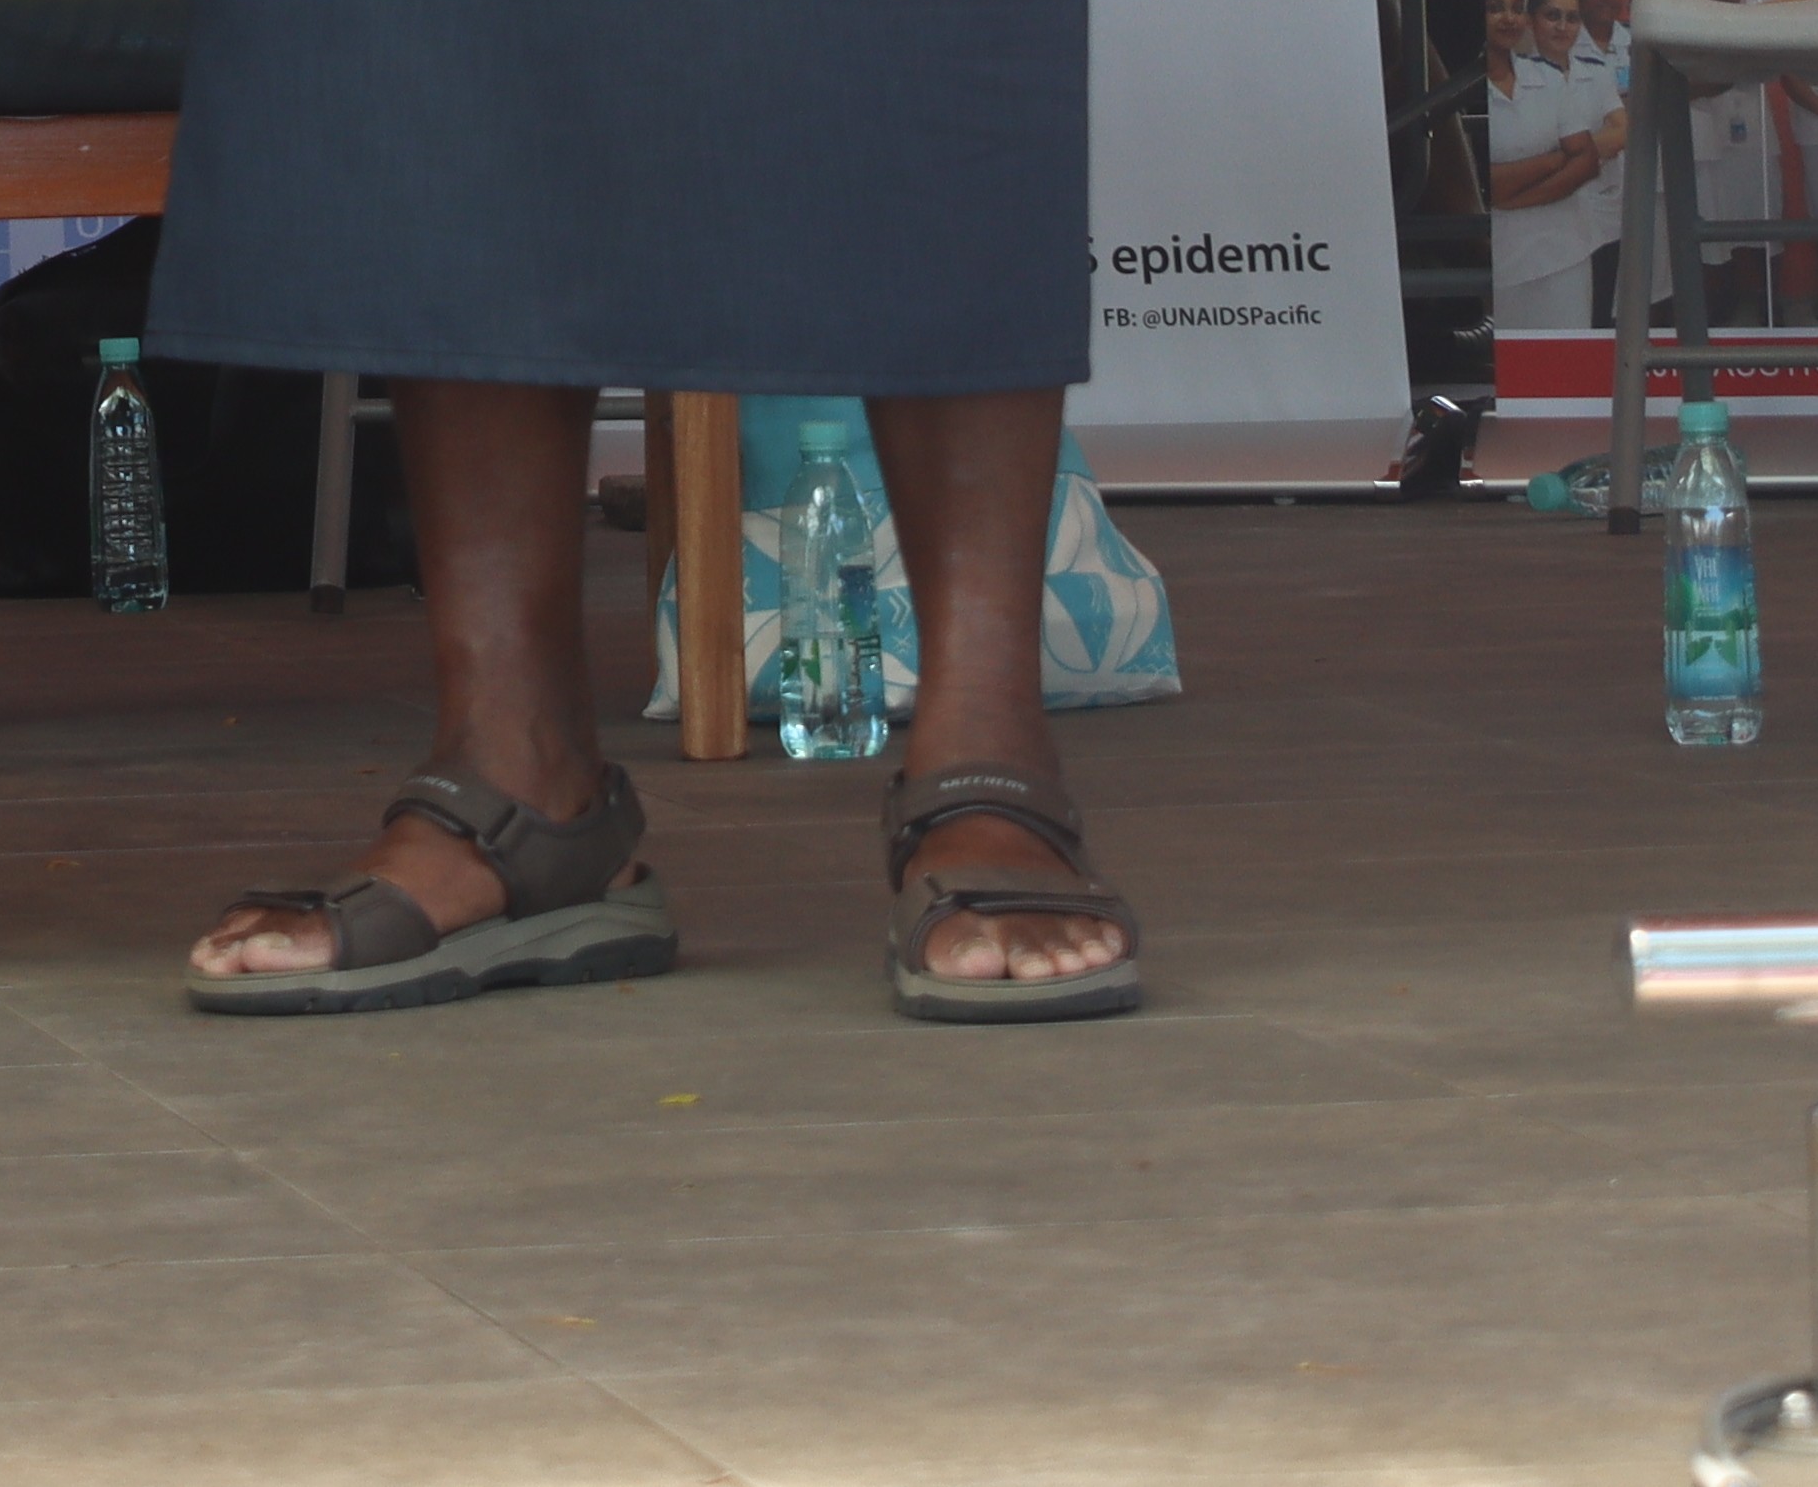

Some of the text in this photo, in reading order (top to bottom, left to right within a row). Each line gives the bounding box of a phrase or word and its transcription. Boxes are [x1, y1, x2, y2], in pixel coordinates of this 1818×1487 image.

[1112, 232, 1330, 284] epidemic
[1103, 304, 1321, 329] FB: @UNAIDSPacific
